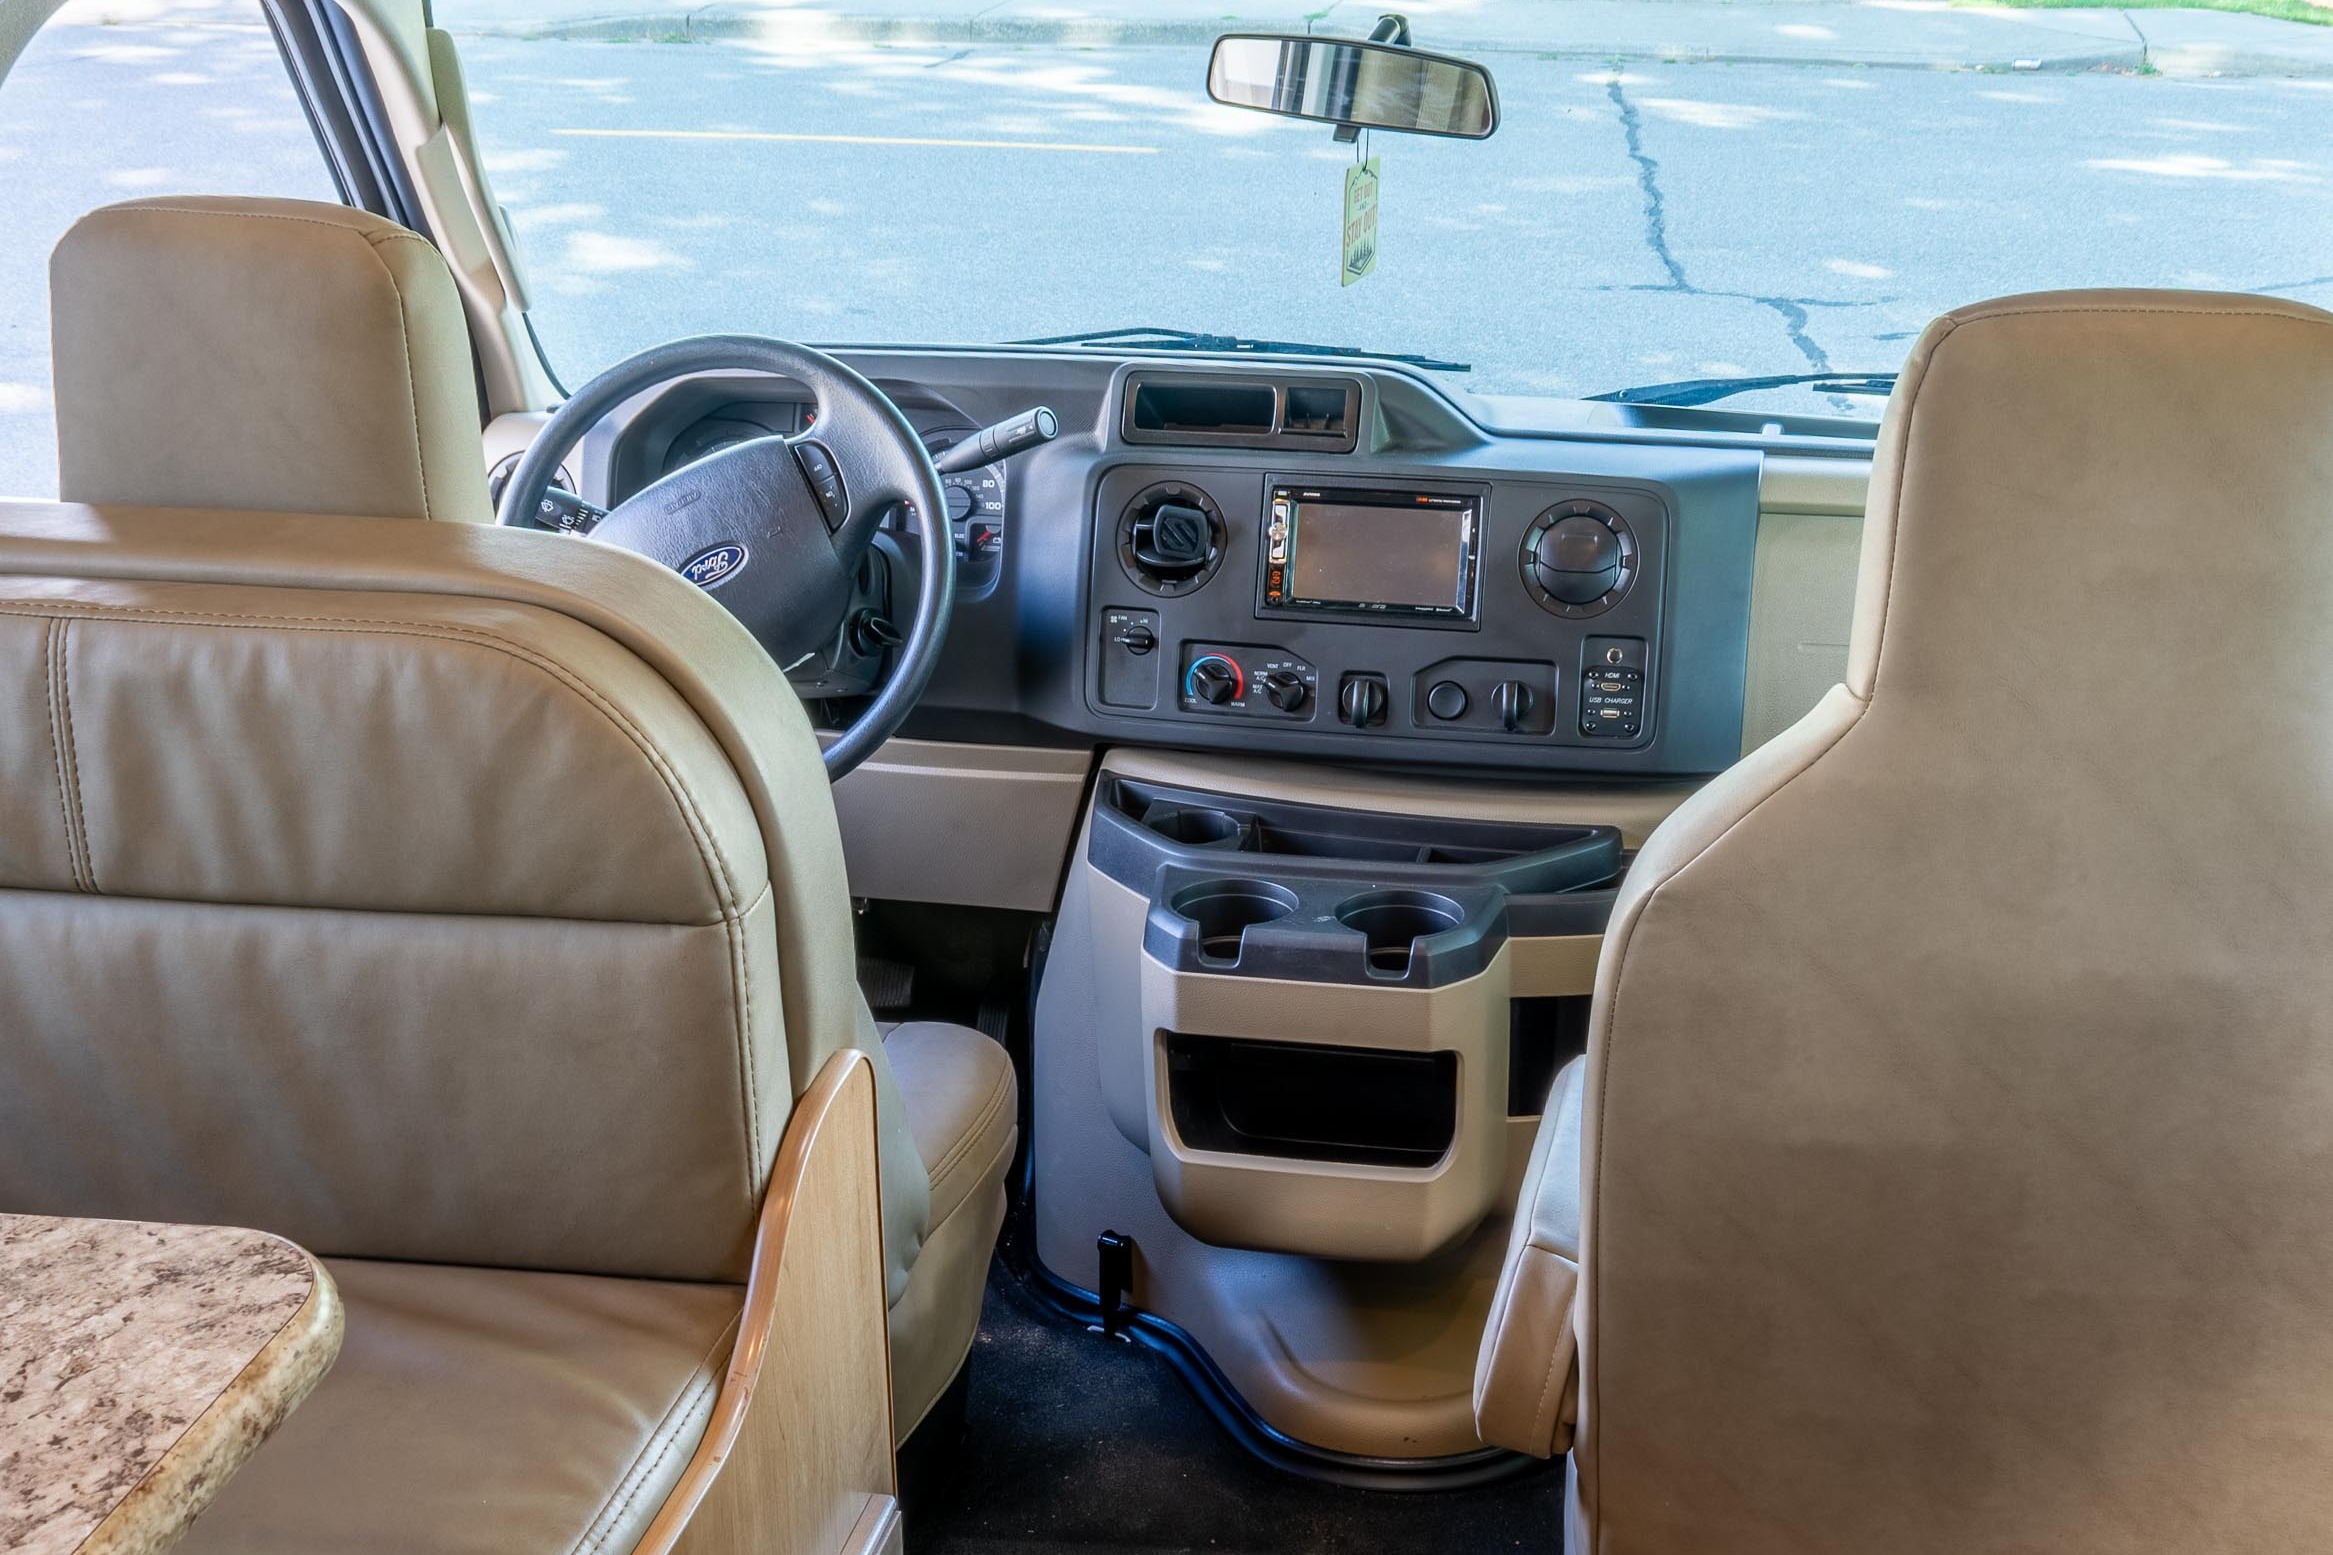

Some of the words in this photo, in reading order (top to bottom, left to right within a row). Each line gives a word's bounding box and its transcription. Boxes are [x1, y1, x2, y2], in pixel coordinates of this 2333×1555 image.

[1346, 216, 1362, 248] STAY
[1364, 203, 1377, 233] OUT
[982, 479, 995, 488] 80
[985, 502, 1002, 510] 100
[691, 551, 729, 580] Ford
